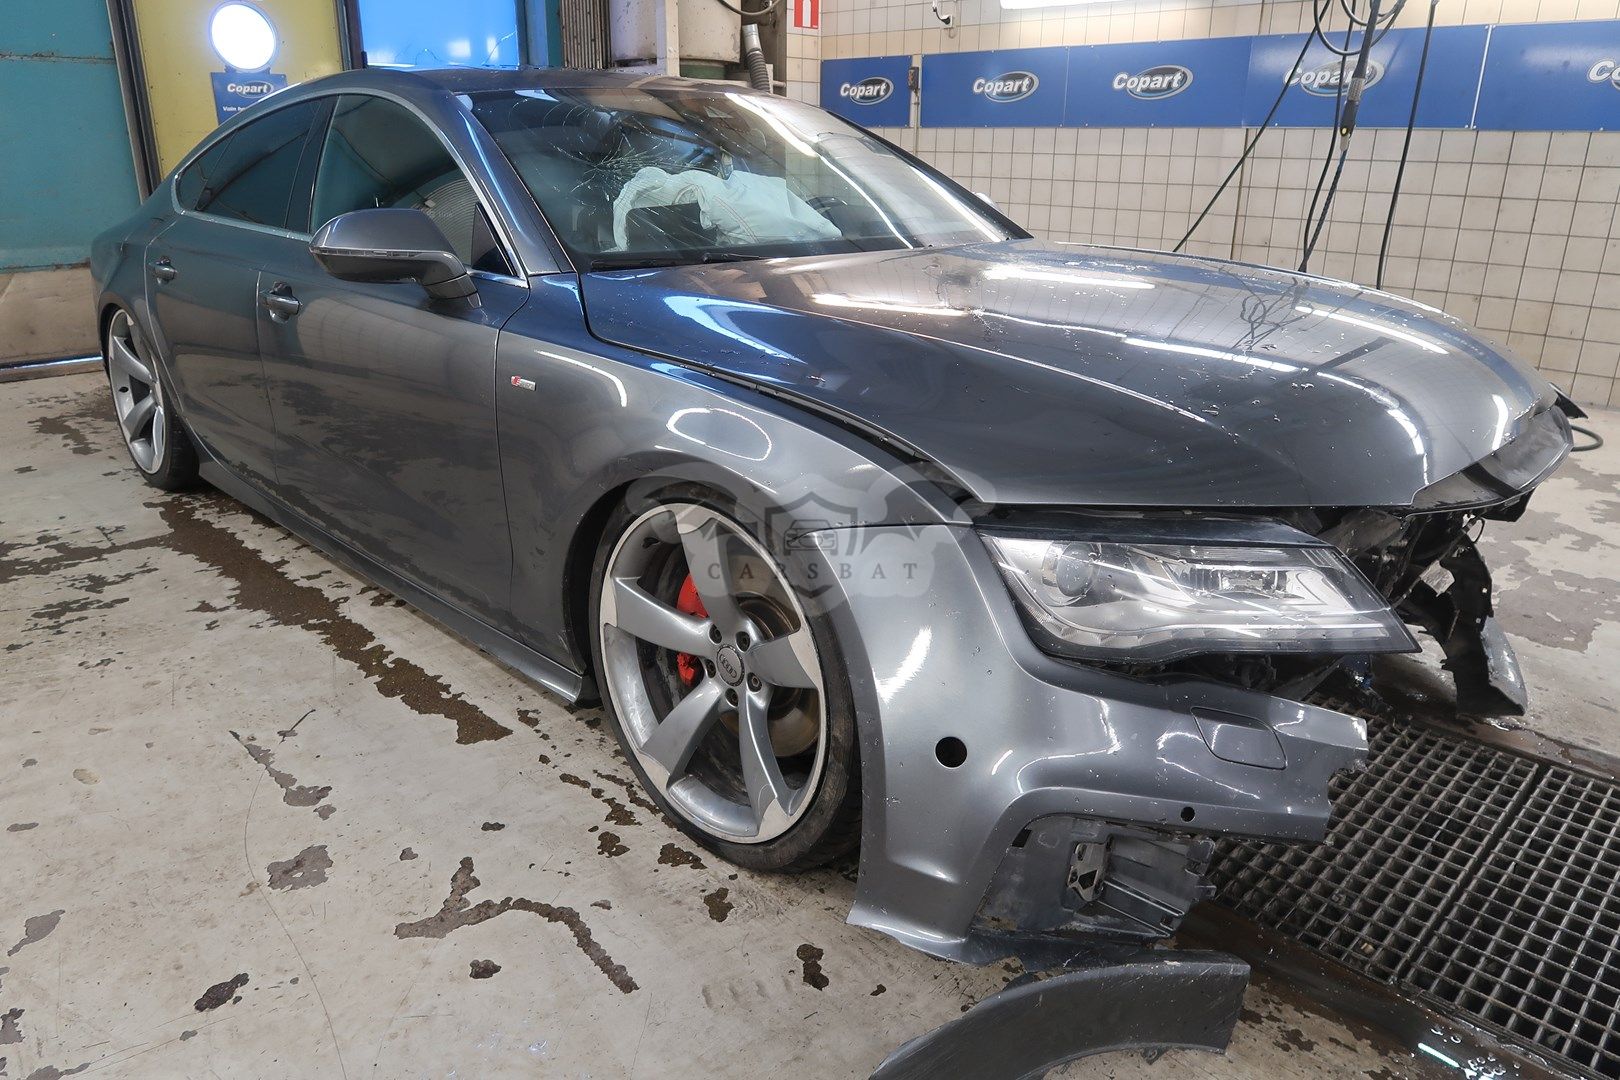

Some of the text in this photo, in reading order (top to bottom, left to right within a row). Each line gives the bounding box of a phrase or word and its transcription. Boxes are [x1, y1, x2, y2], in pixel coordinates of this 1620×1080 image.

[973, 77, 1030, 96] Copart
[1113, 71, 1182, 92] Copart
[1284, 67, 1370, 89] Copar
[227, 83, 268, 95] Copart
[840, 82, 887, 98] Copart
